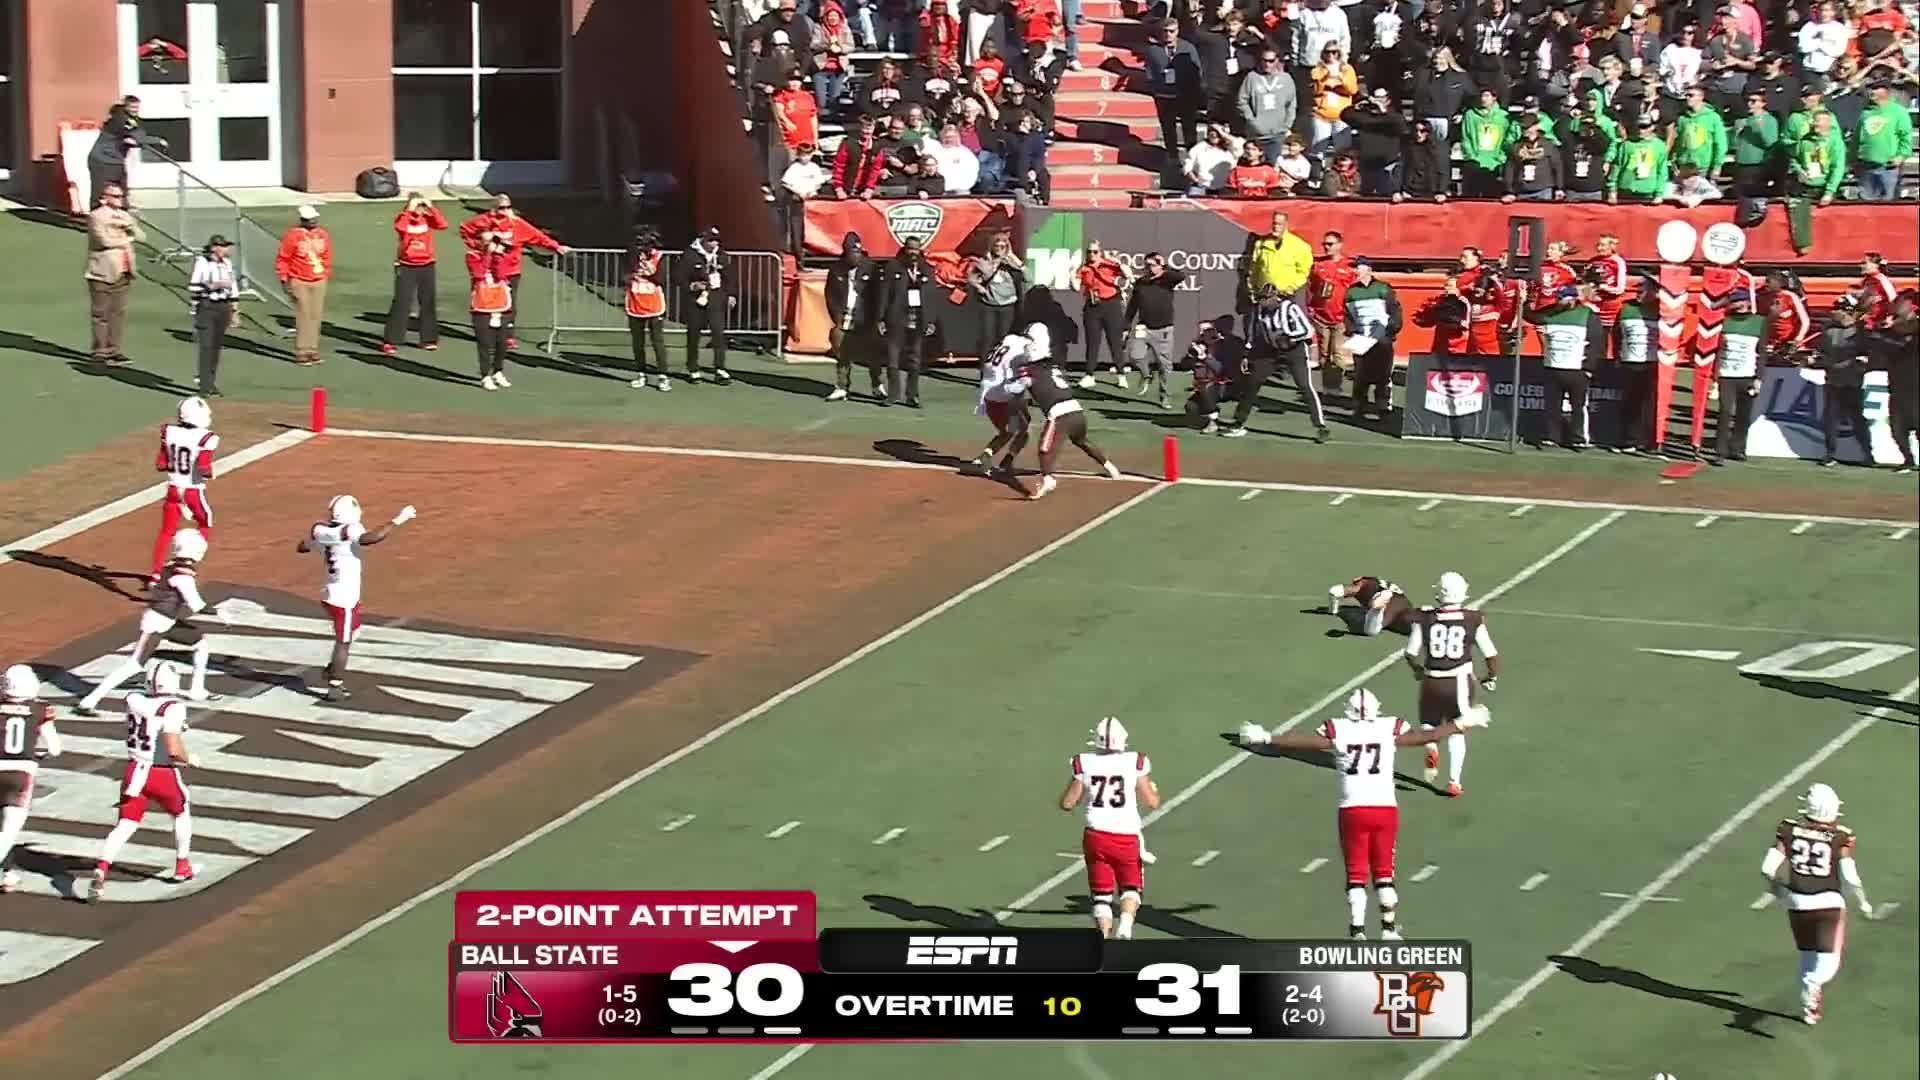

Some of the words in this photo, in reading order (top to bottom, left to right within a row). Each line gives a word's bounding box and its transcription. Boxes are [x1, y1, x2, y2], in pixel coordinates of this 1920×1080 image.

[1098, 101, 1108, 116] 7
[892, 218, 938, 232] MAC
[1516, 225, 1530, 256] 1
[1168, 250, 1242, 270] COUN
[168, 443, 191, 475] 10
[1430, 624, 1466, 659] 88
[127, 713, 151, 751] 24
[1347, 743, 1381, 775] 77
[1090, 775, 1126, 808] 73
[1792, 838, 1832, 876] 23
